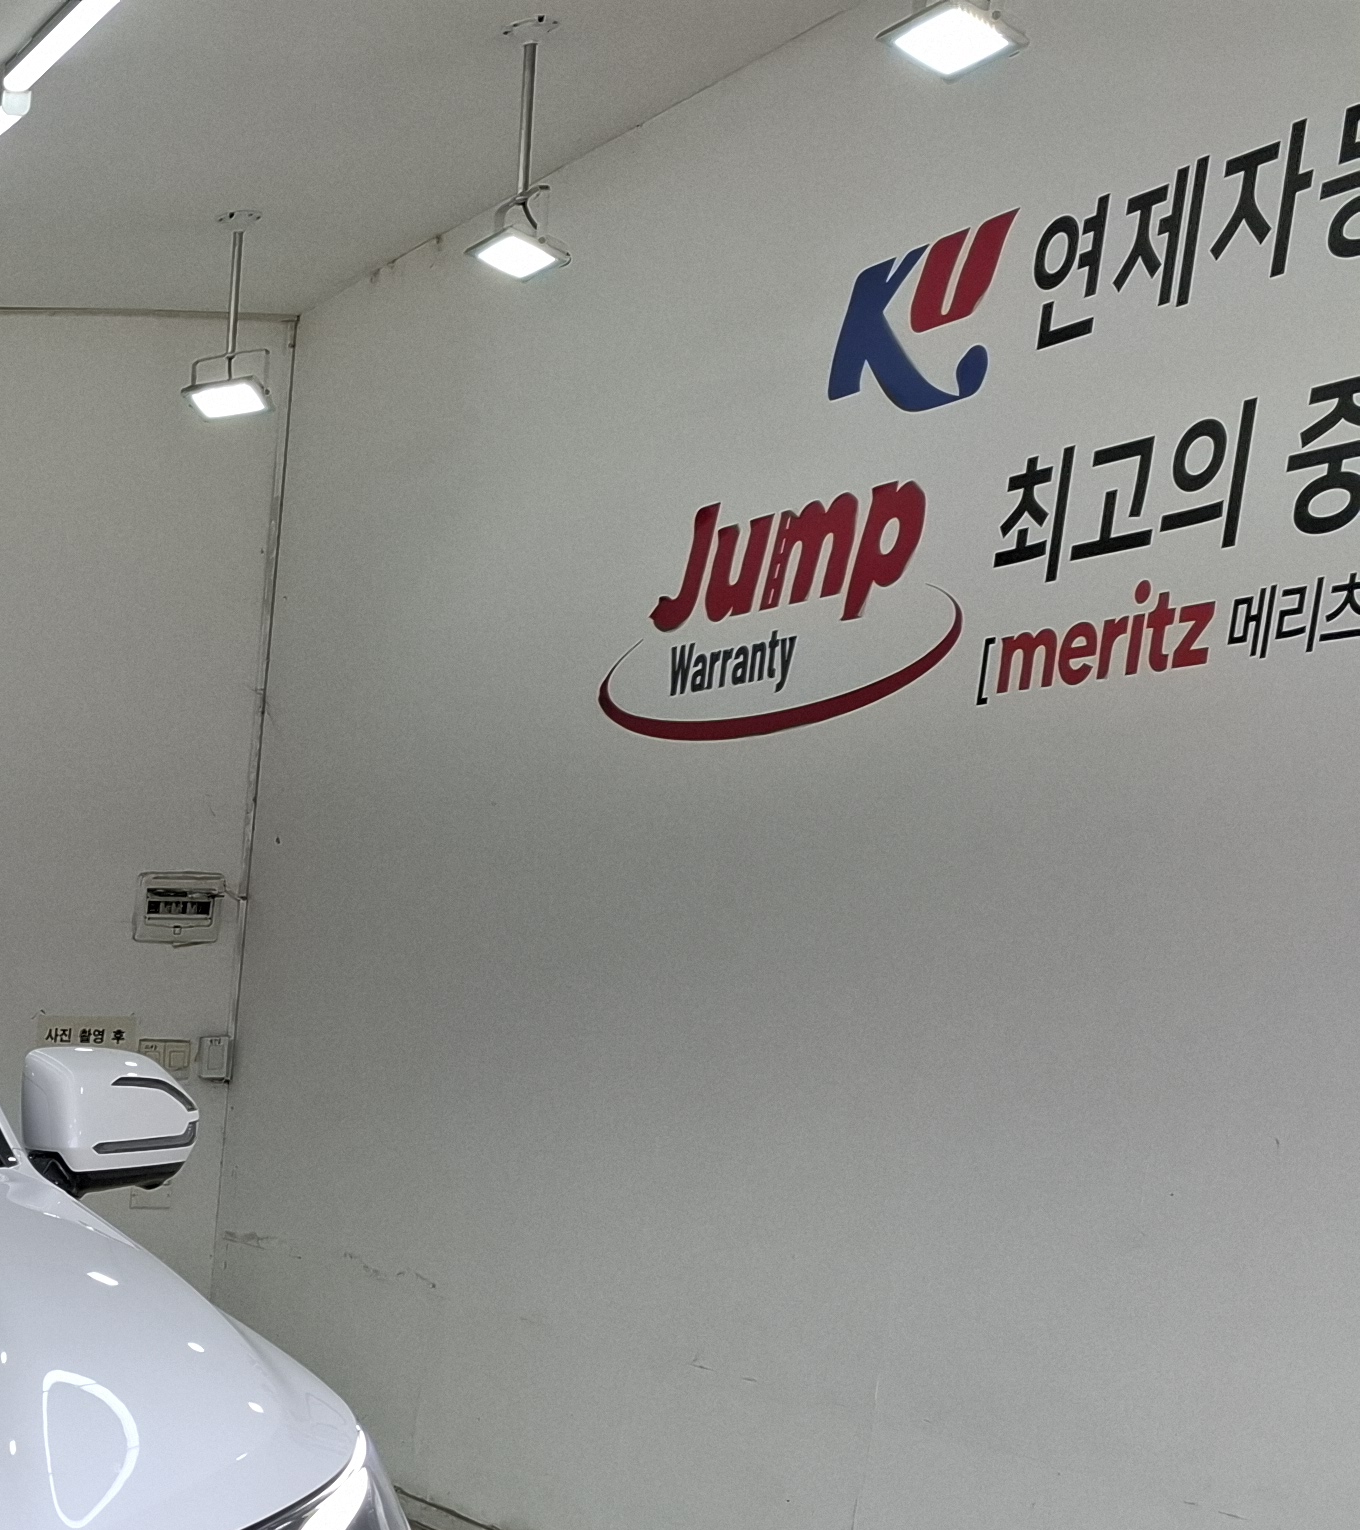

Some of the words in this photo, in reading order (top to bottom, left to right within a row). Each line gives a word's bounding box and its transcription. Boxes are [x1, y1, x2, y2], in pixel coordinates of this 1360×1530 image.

[993, 396, 1258, 583] 최고의
[649, 480, 927, 634] Jump
[670, 630, 797, 696] Warranty
[45, 1028, 71, 1043] 사진
[111, 1029, 126, 1045] 후
